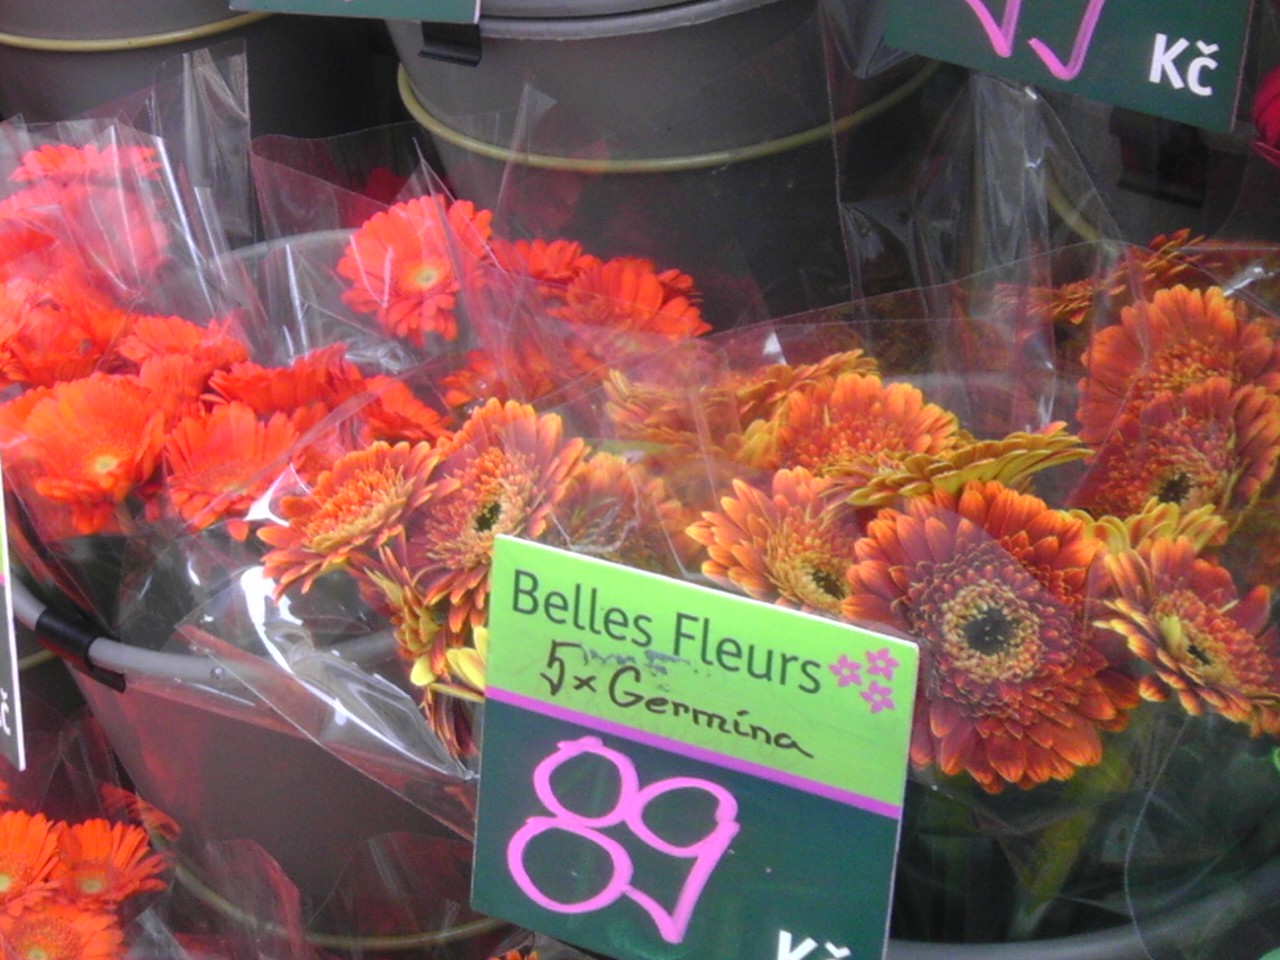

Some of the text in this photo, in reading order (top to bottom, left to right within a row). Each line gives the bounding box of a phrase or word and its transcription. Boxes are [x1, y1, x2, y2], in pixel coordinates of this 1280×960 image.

[1149, 32, 1219, 96] Kč
[512, 569, 822, 694] Belles Fleurs
[507, 735, 741, 945] 89
